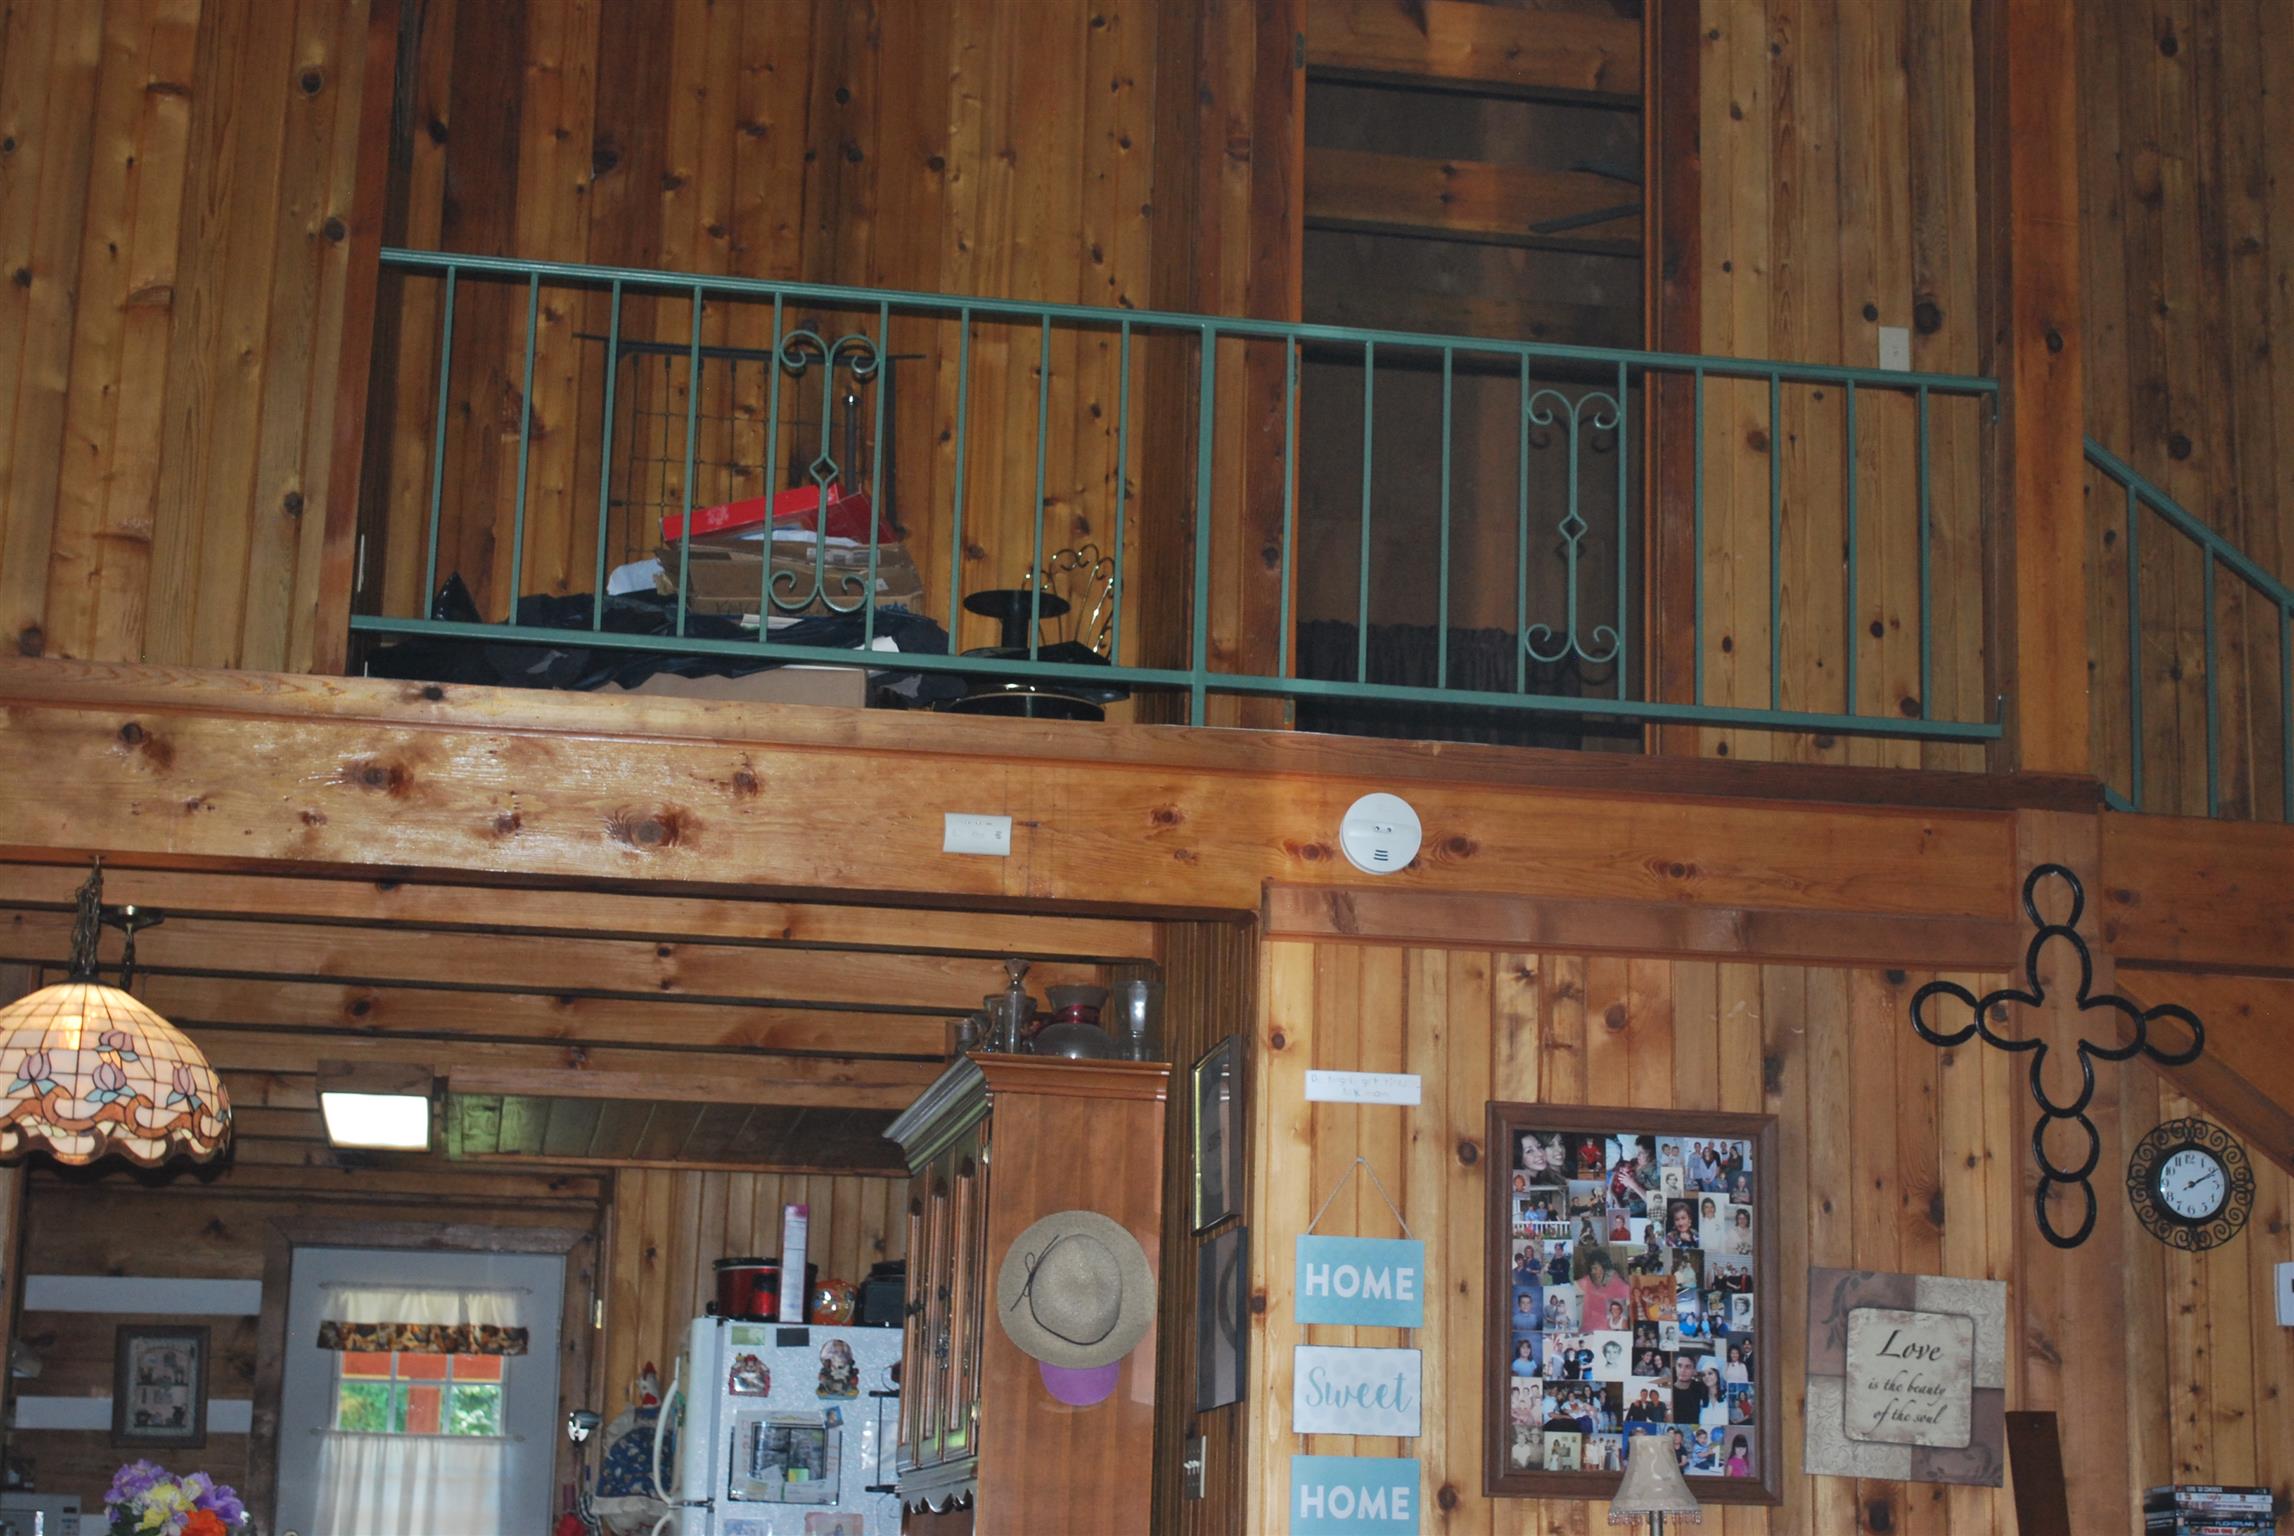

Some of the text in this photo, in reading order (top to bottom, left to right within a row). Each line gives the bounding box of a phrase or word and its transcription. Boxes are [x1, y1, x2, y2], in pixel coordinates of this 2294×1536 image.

[1305, 1263, 1415, 1301] HOME
[1876, 1329, 1944, 1362] Love
[1305, 1366, 1413, 1412] Sweet
[1868, 1370, 1946, 1406] is the beauty
[1861, 1398, 1948, 1436] of the soul
[1300, 1484, 1410, 1521] HOME
